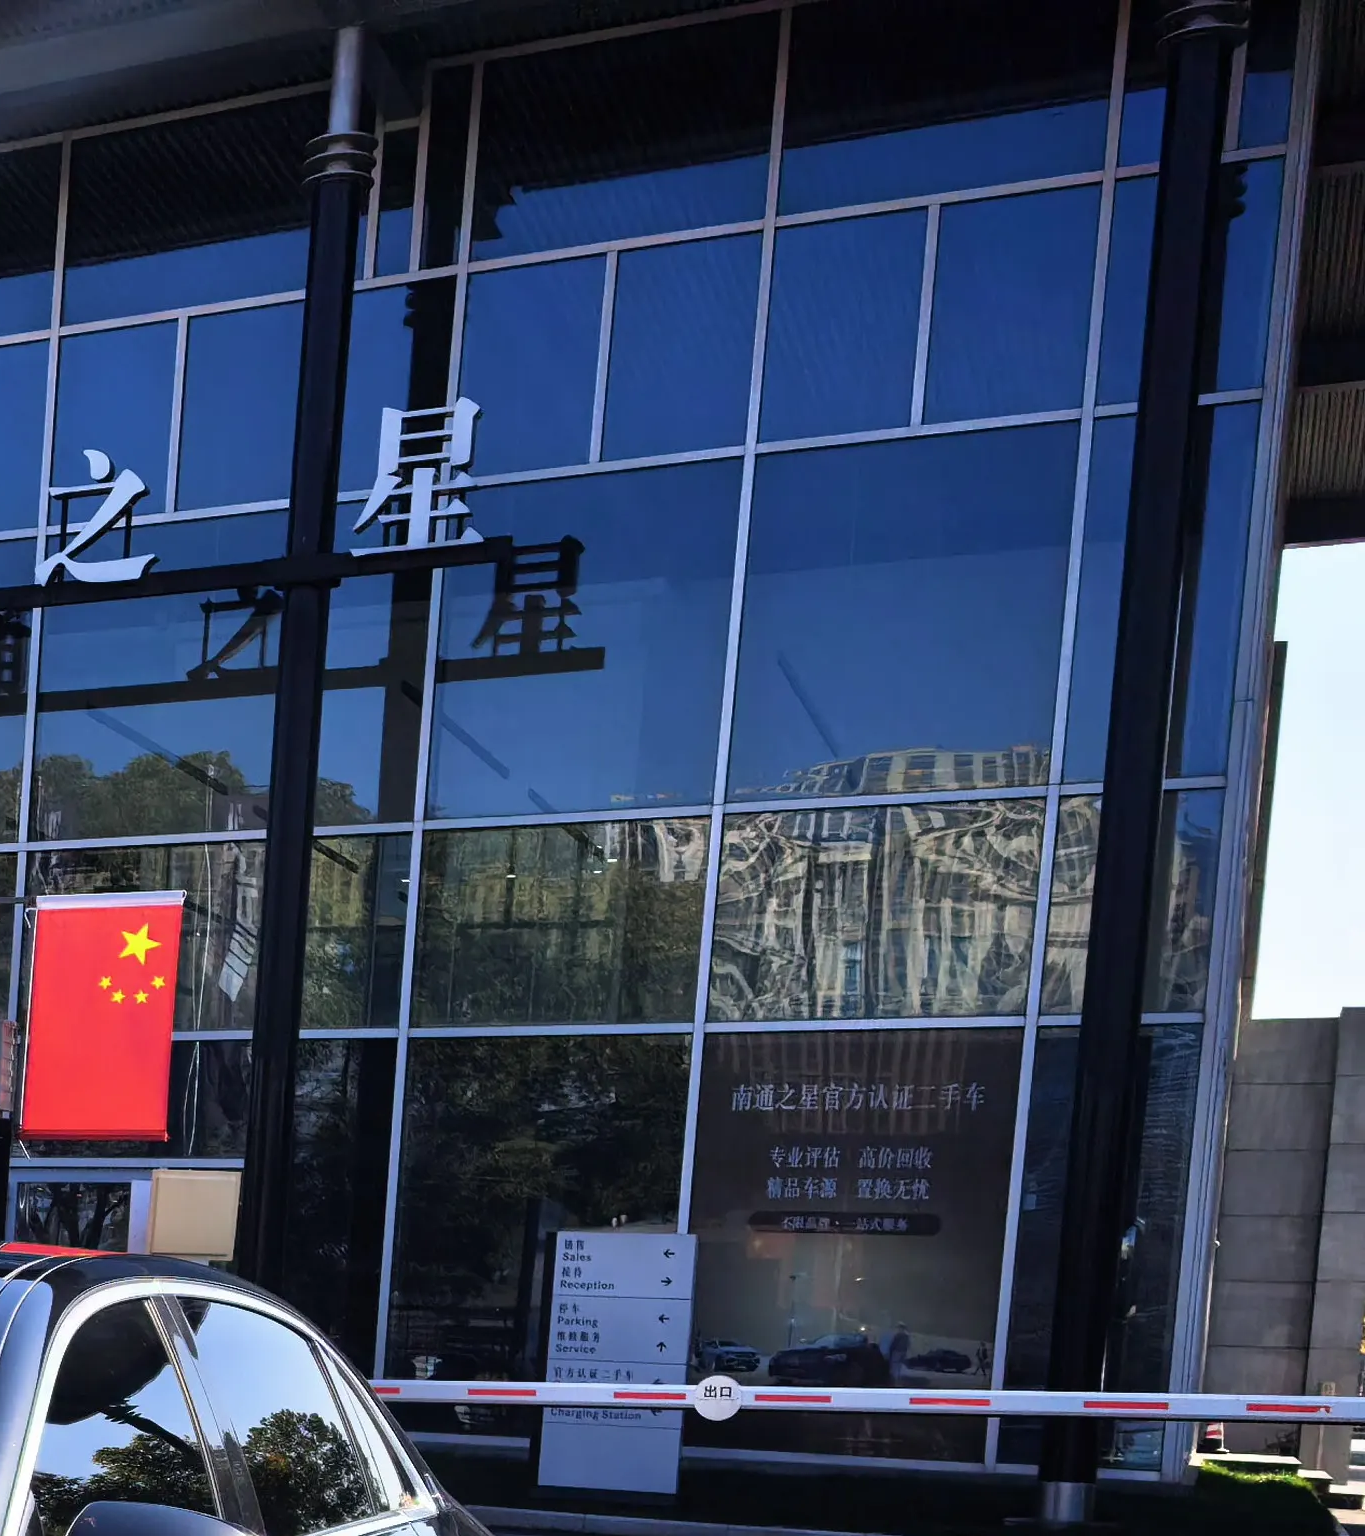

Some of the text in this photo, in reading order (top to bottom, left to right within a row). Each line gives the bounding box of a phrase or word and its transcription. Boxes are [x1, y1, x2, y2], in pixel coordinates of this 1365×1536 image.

[731, 1082, 986, 1112] 南通之星官方认证二手车
[769, 1146, 933, 1170] 专业评估 高价回收
[767, 1177, 930, 1200] 精品车源 置换无忧
[562, 1251, 592, 1262] Sales
[560, 1279, 615, 1291] Reception
[557, 1316, 598, 1328] Parking
[555, 1343, 597, 1355] Service
[704, 1385, 732, 1399] 出口
[550, 1407, 642, 1420] Charging Station
